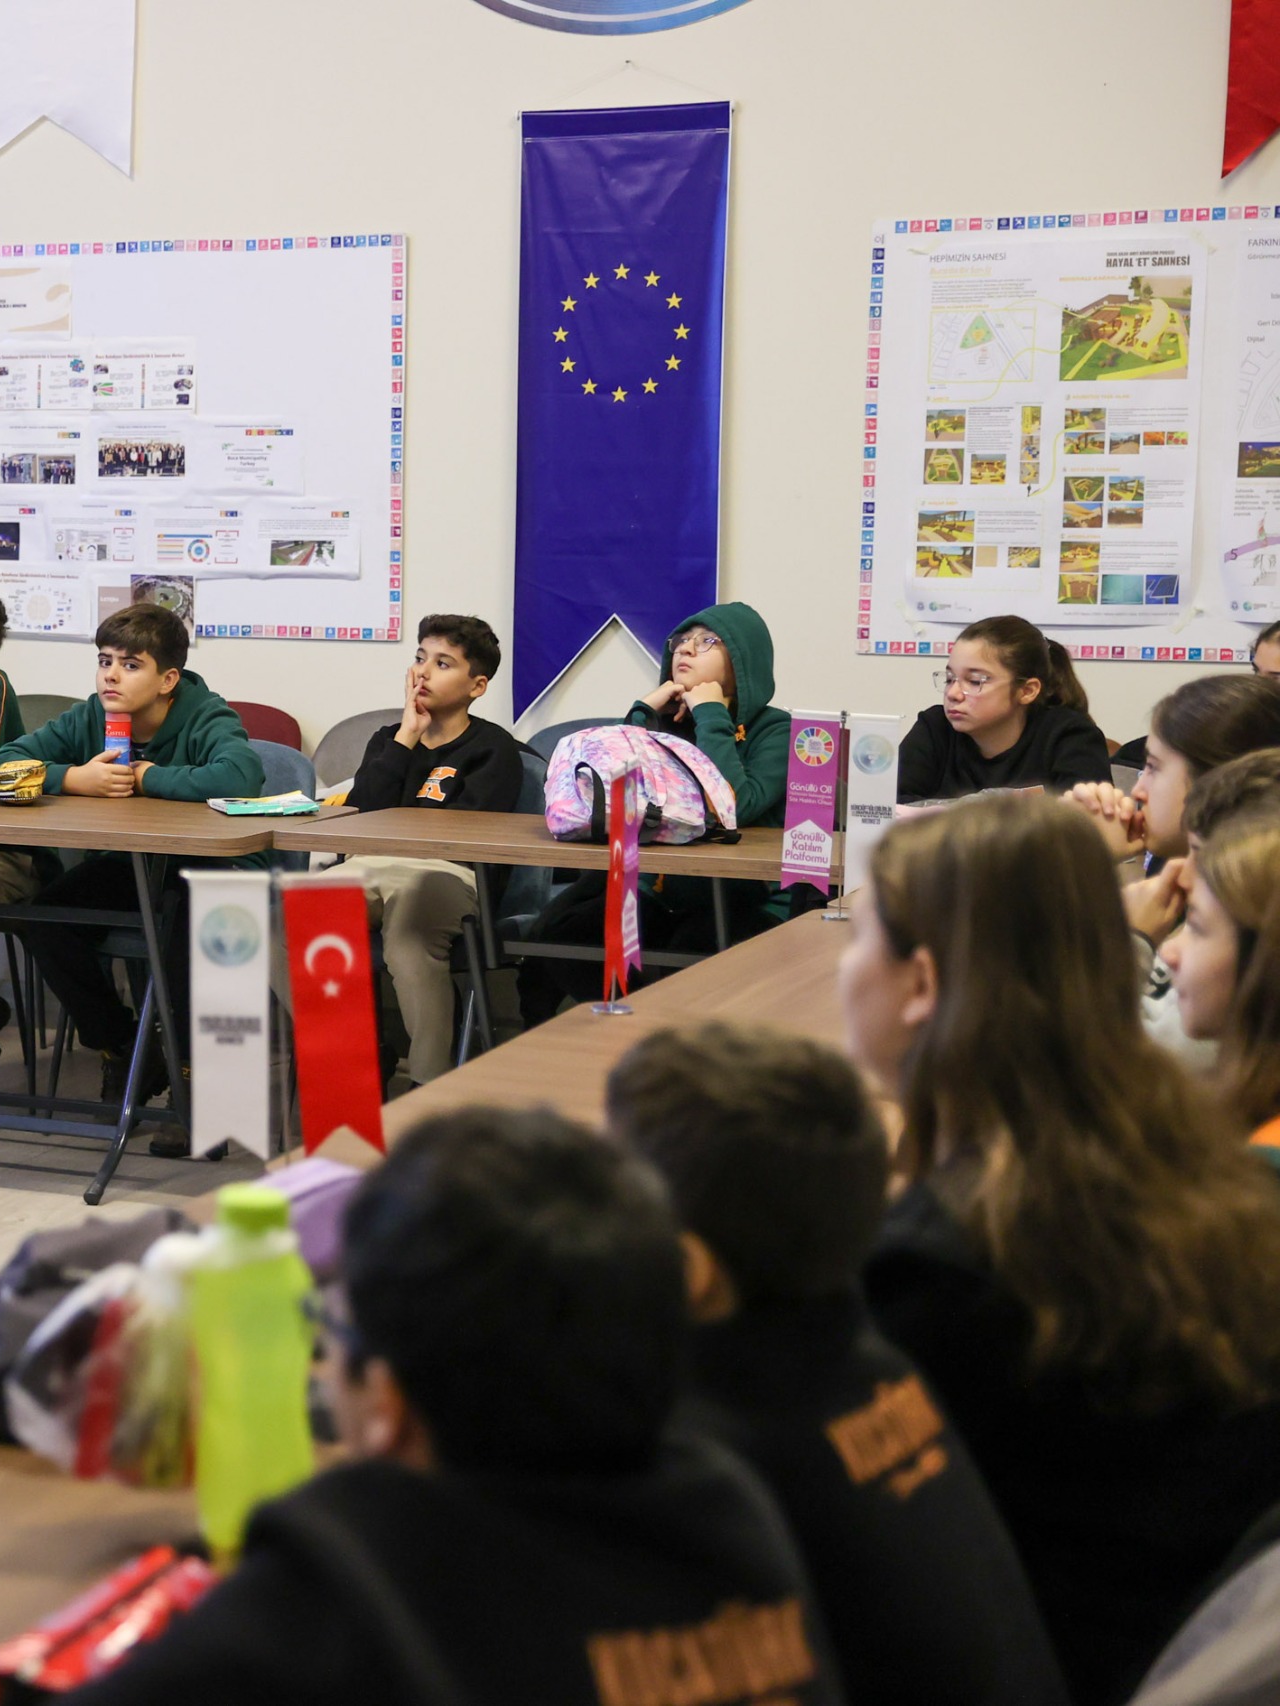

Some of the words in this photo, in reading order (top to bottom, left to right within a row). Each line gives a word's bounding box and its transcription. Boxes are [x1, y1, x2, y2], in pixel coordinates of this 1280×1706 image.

[1247, 239, 1280, 247] FARKIN
[1151, 254, 1191, 267] SAHNESİ
[790, 830, 826, 842] Gönüllü
[792, 841, 823, 853] Katılım
[785, 849, 828, 864] Platformu
